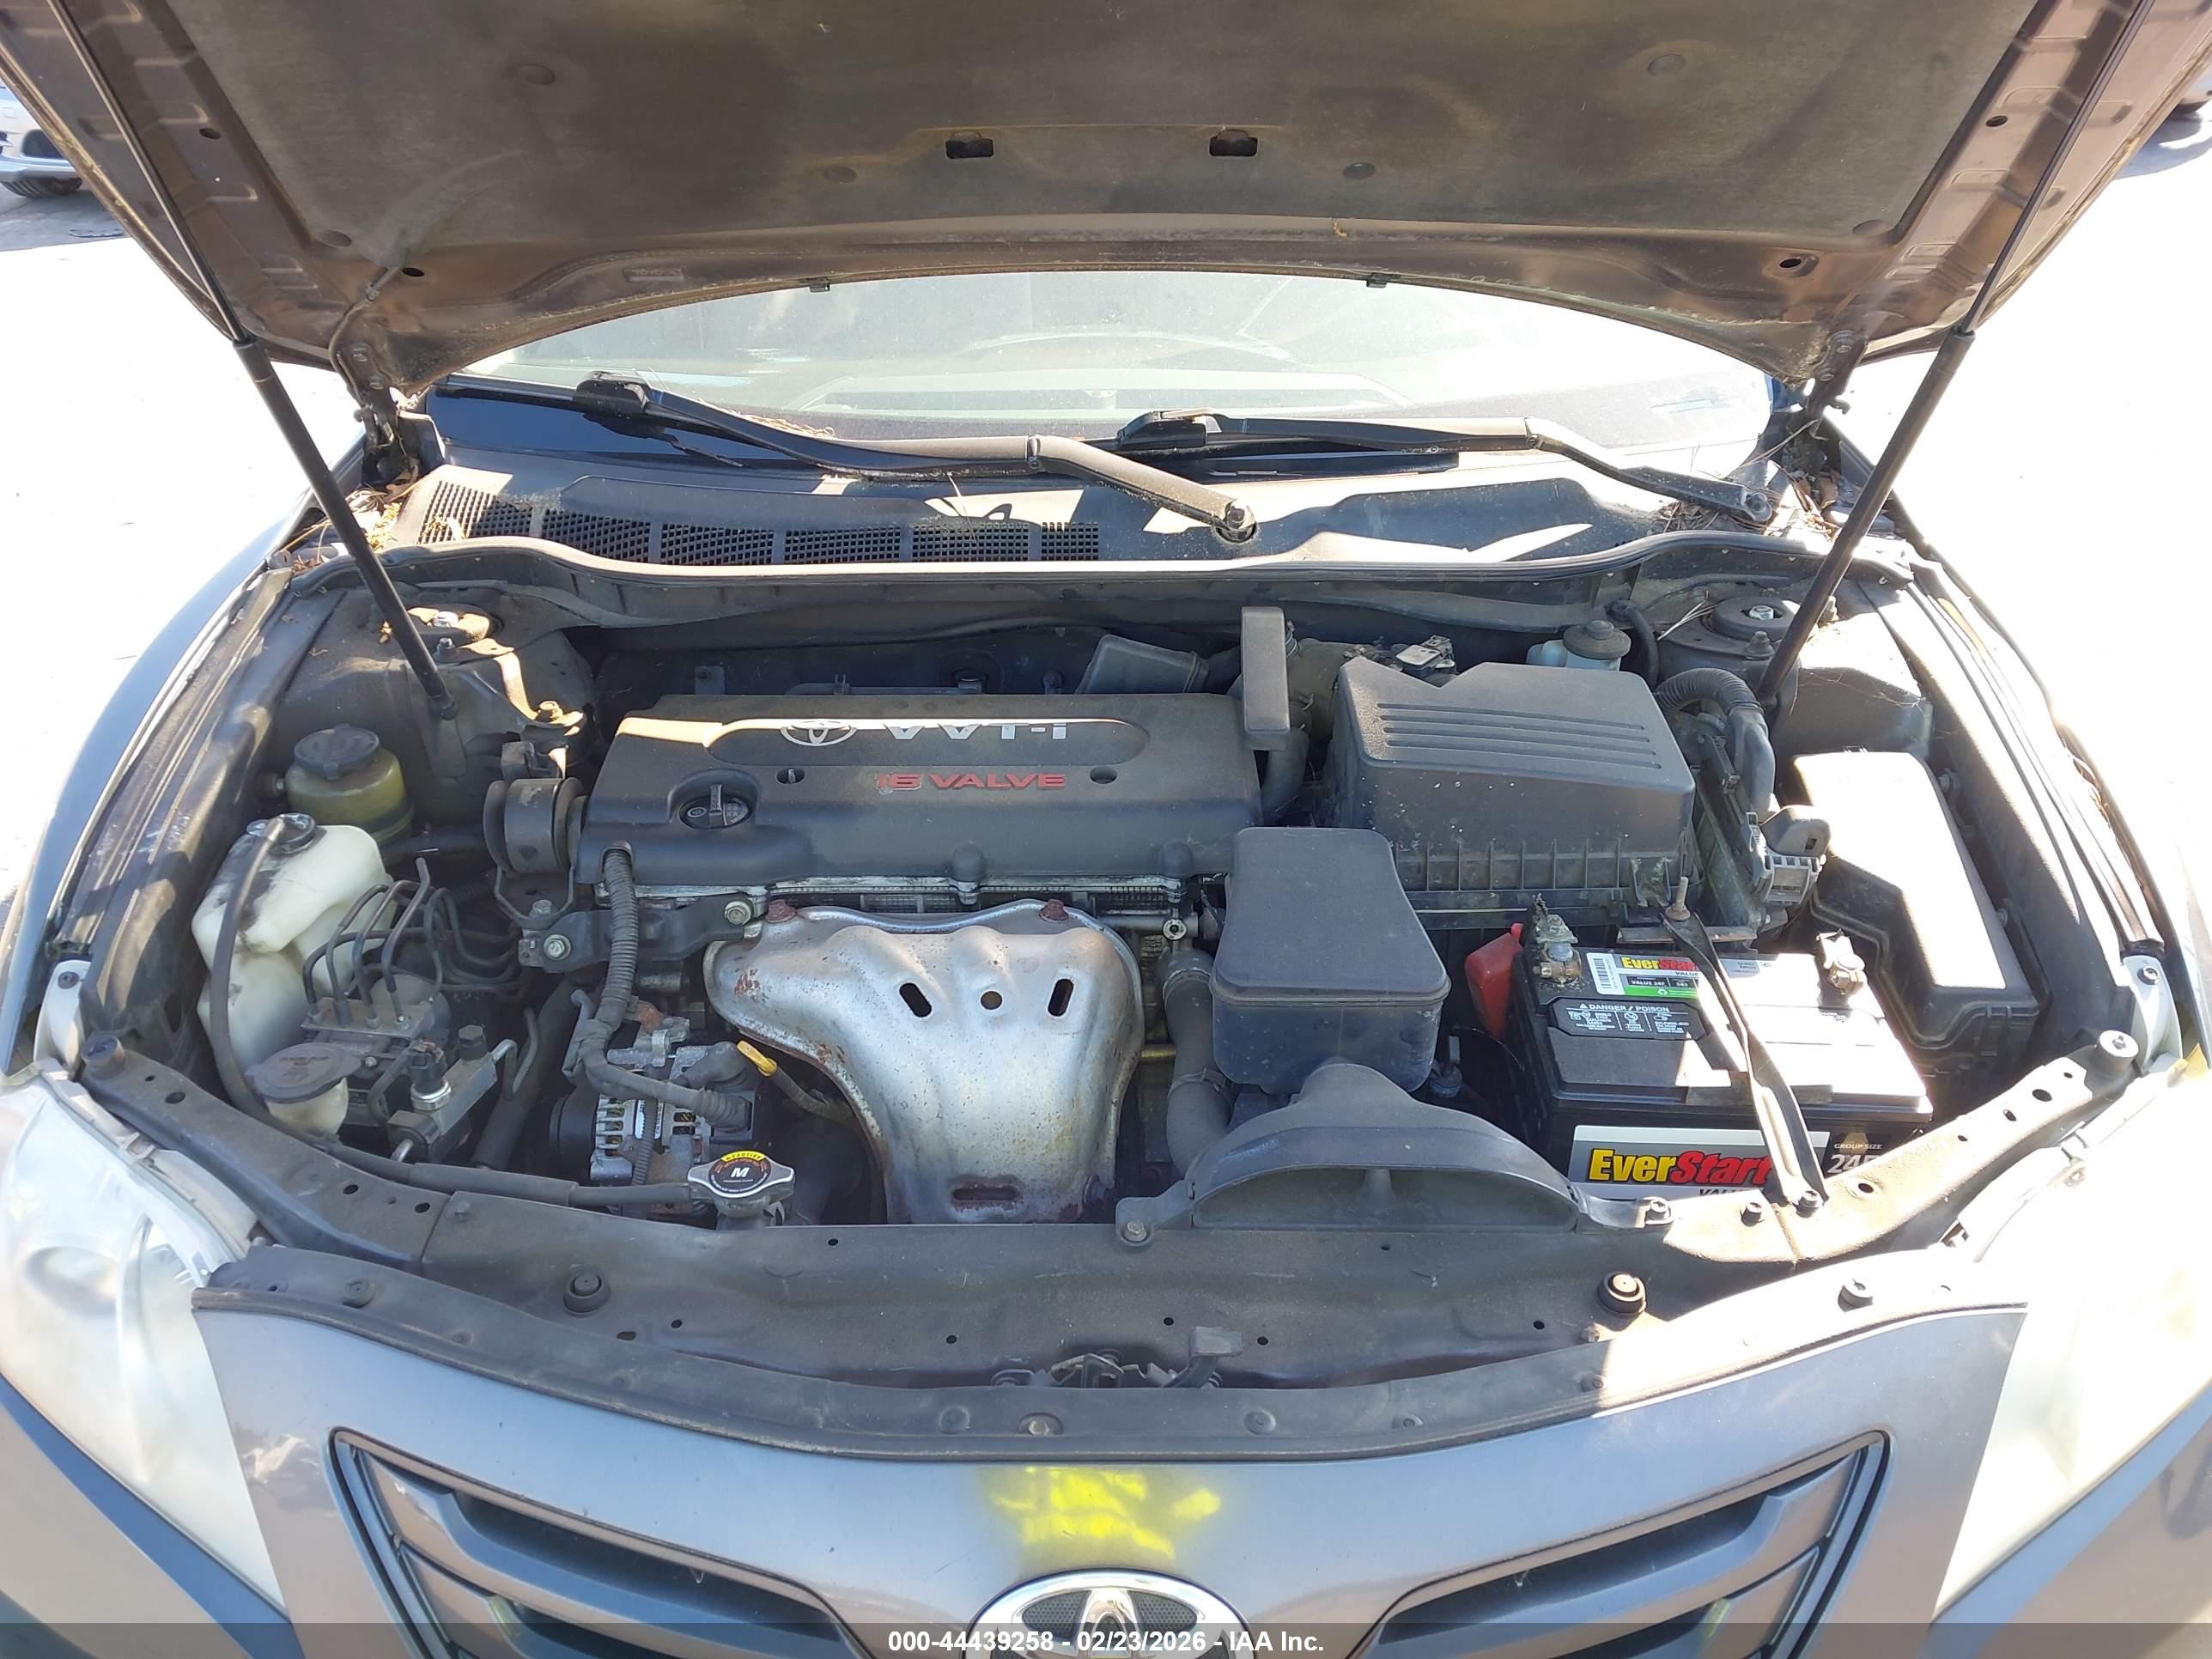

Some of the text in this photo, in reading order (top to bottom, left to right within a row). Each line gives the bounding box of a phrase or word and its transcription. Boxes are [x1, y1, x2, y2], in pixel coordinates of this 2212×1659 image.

[883, 722, 1066, 740] VVT-i
[929, 772, 1066, 791] VALVE
[1589, 1003, 1626, 1012] DANGER
[730, 1167, 750, 1178] M
[1589, 1147, 1775, 1186] EverStart
